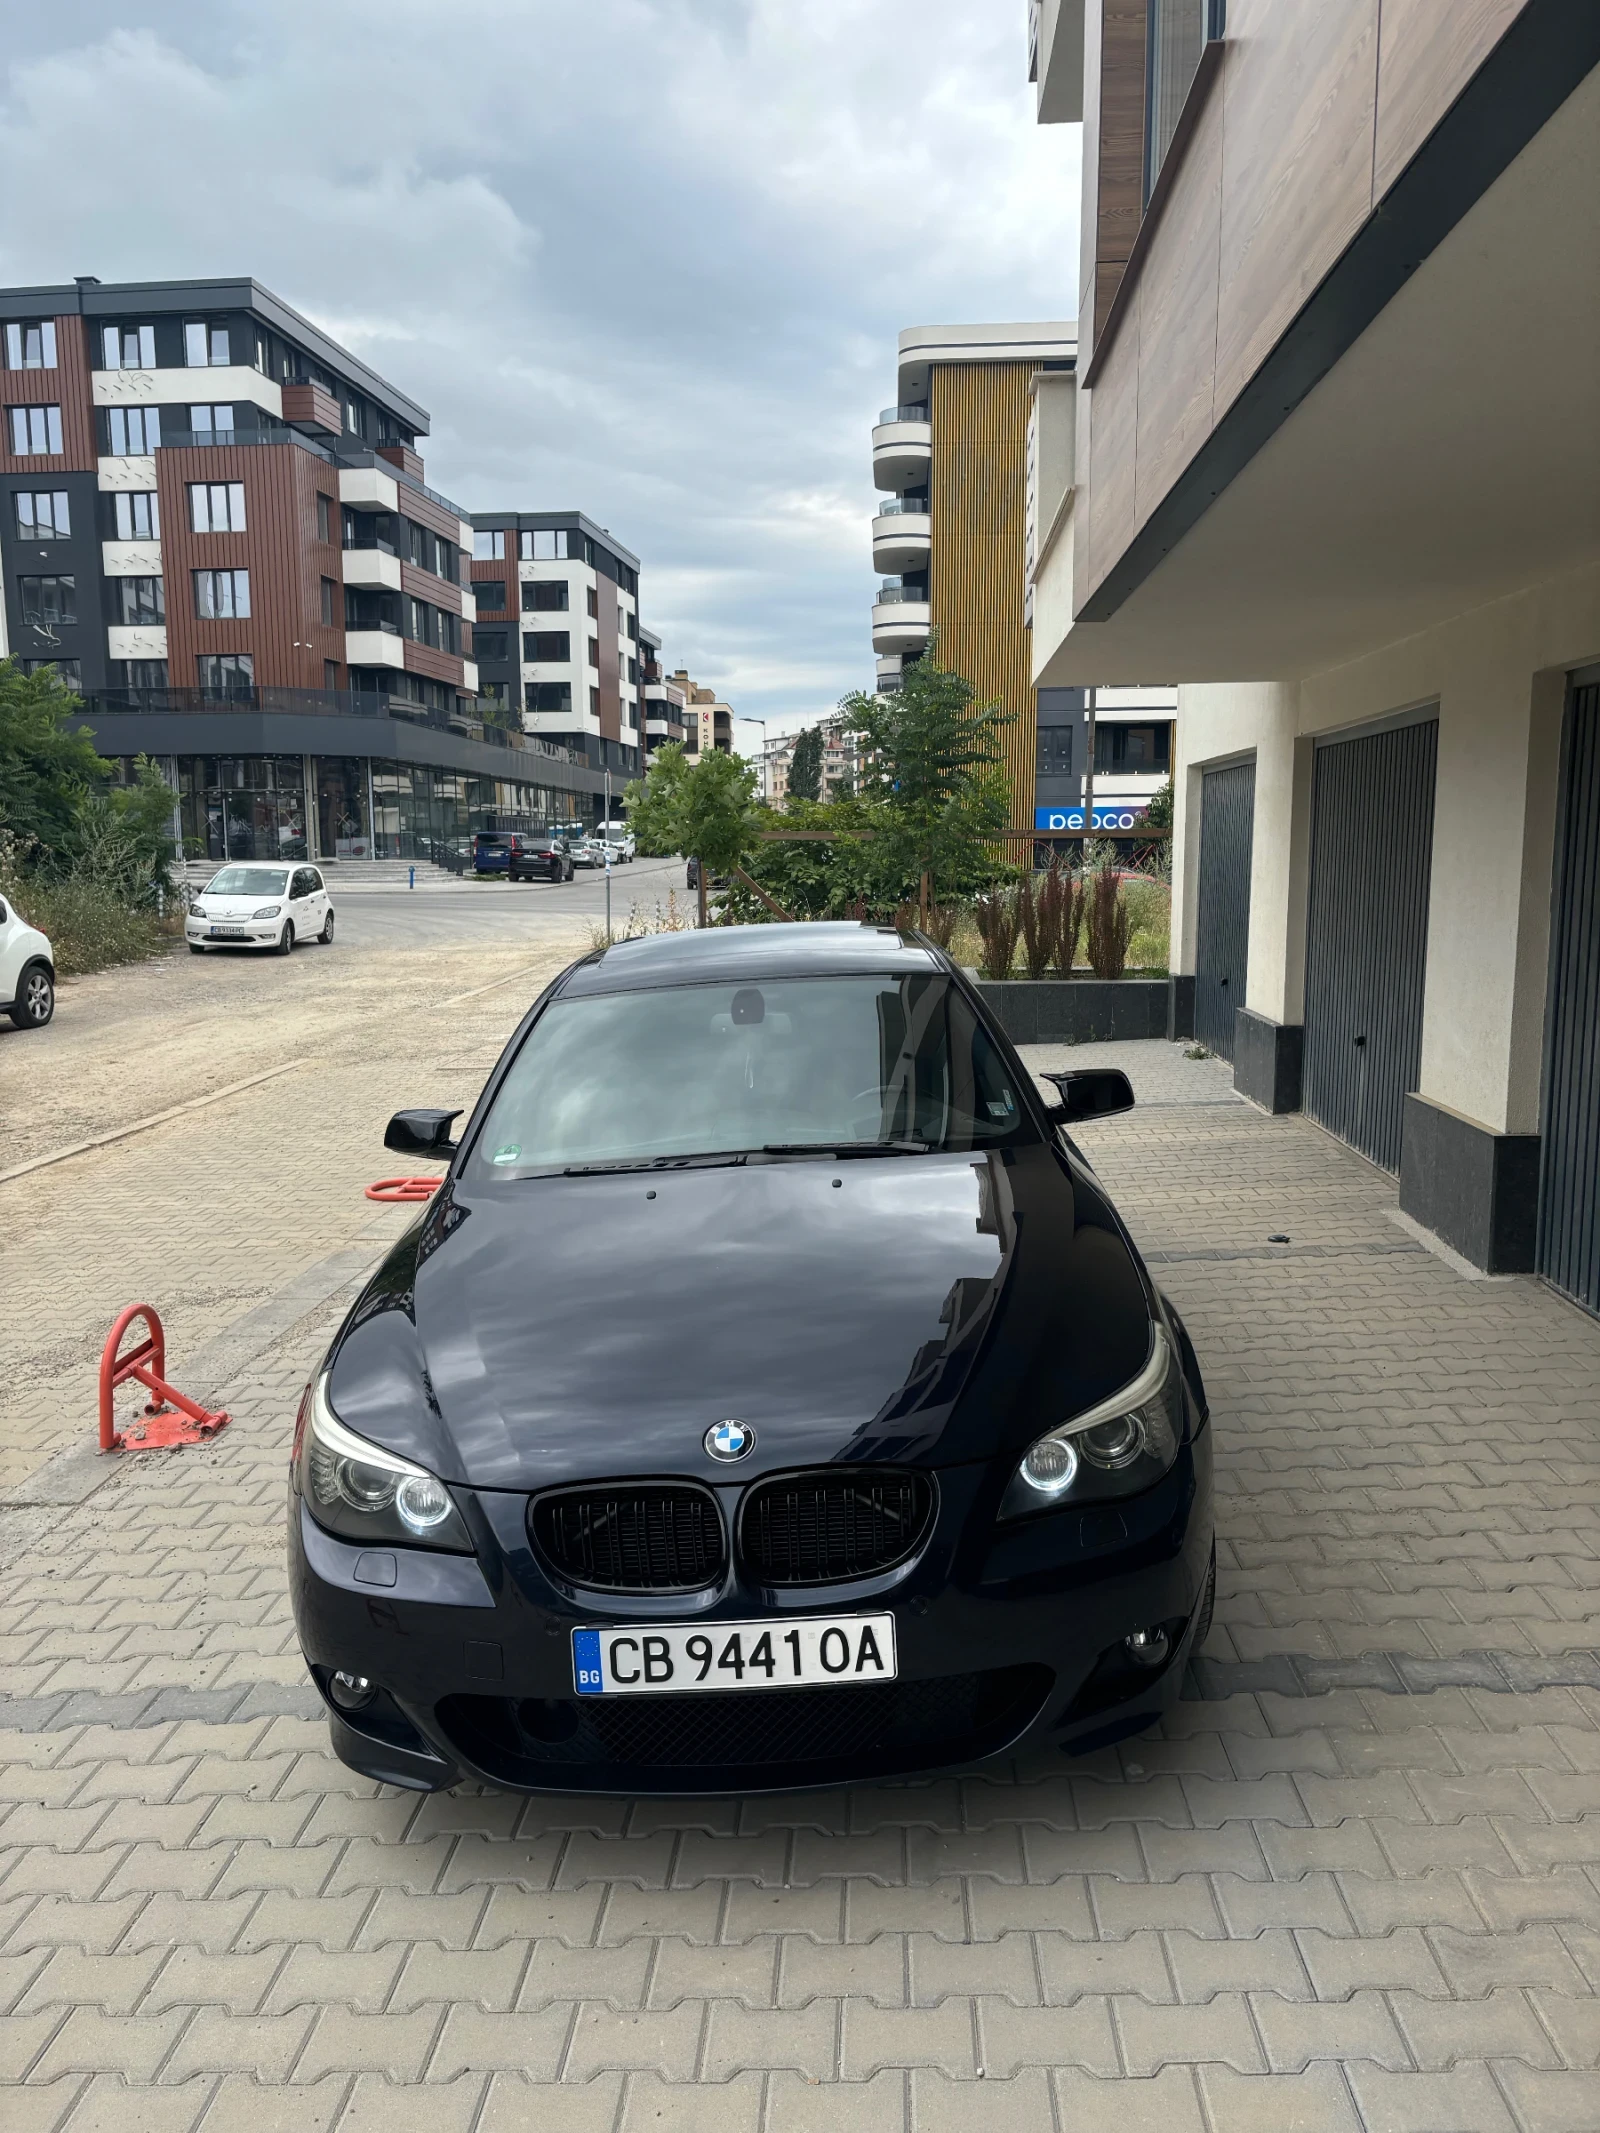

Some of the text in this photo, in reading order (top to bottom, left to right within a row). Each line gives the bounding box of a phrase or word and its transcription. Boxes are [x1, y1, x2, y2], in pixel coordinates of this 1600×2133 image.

[710, 1420, 750, 1434] BMW
[609, 1625, 885, 1684] CB 9441 OA
[579, 1669, 600, 1685] BG
